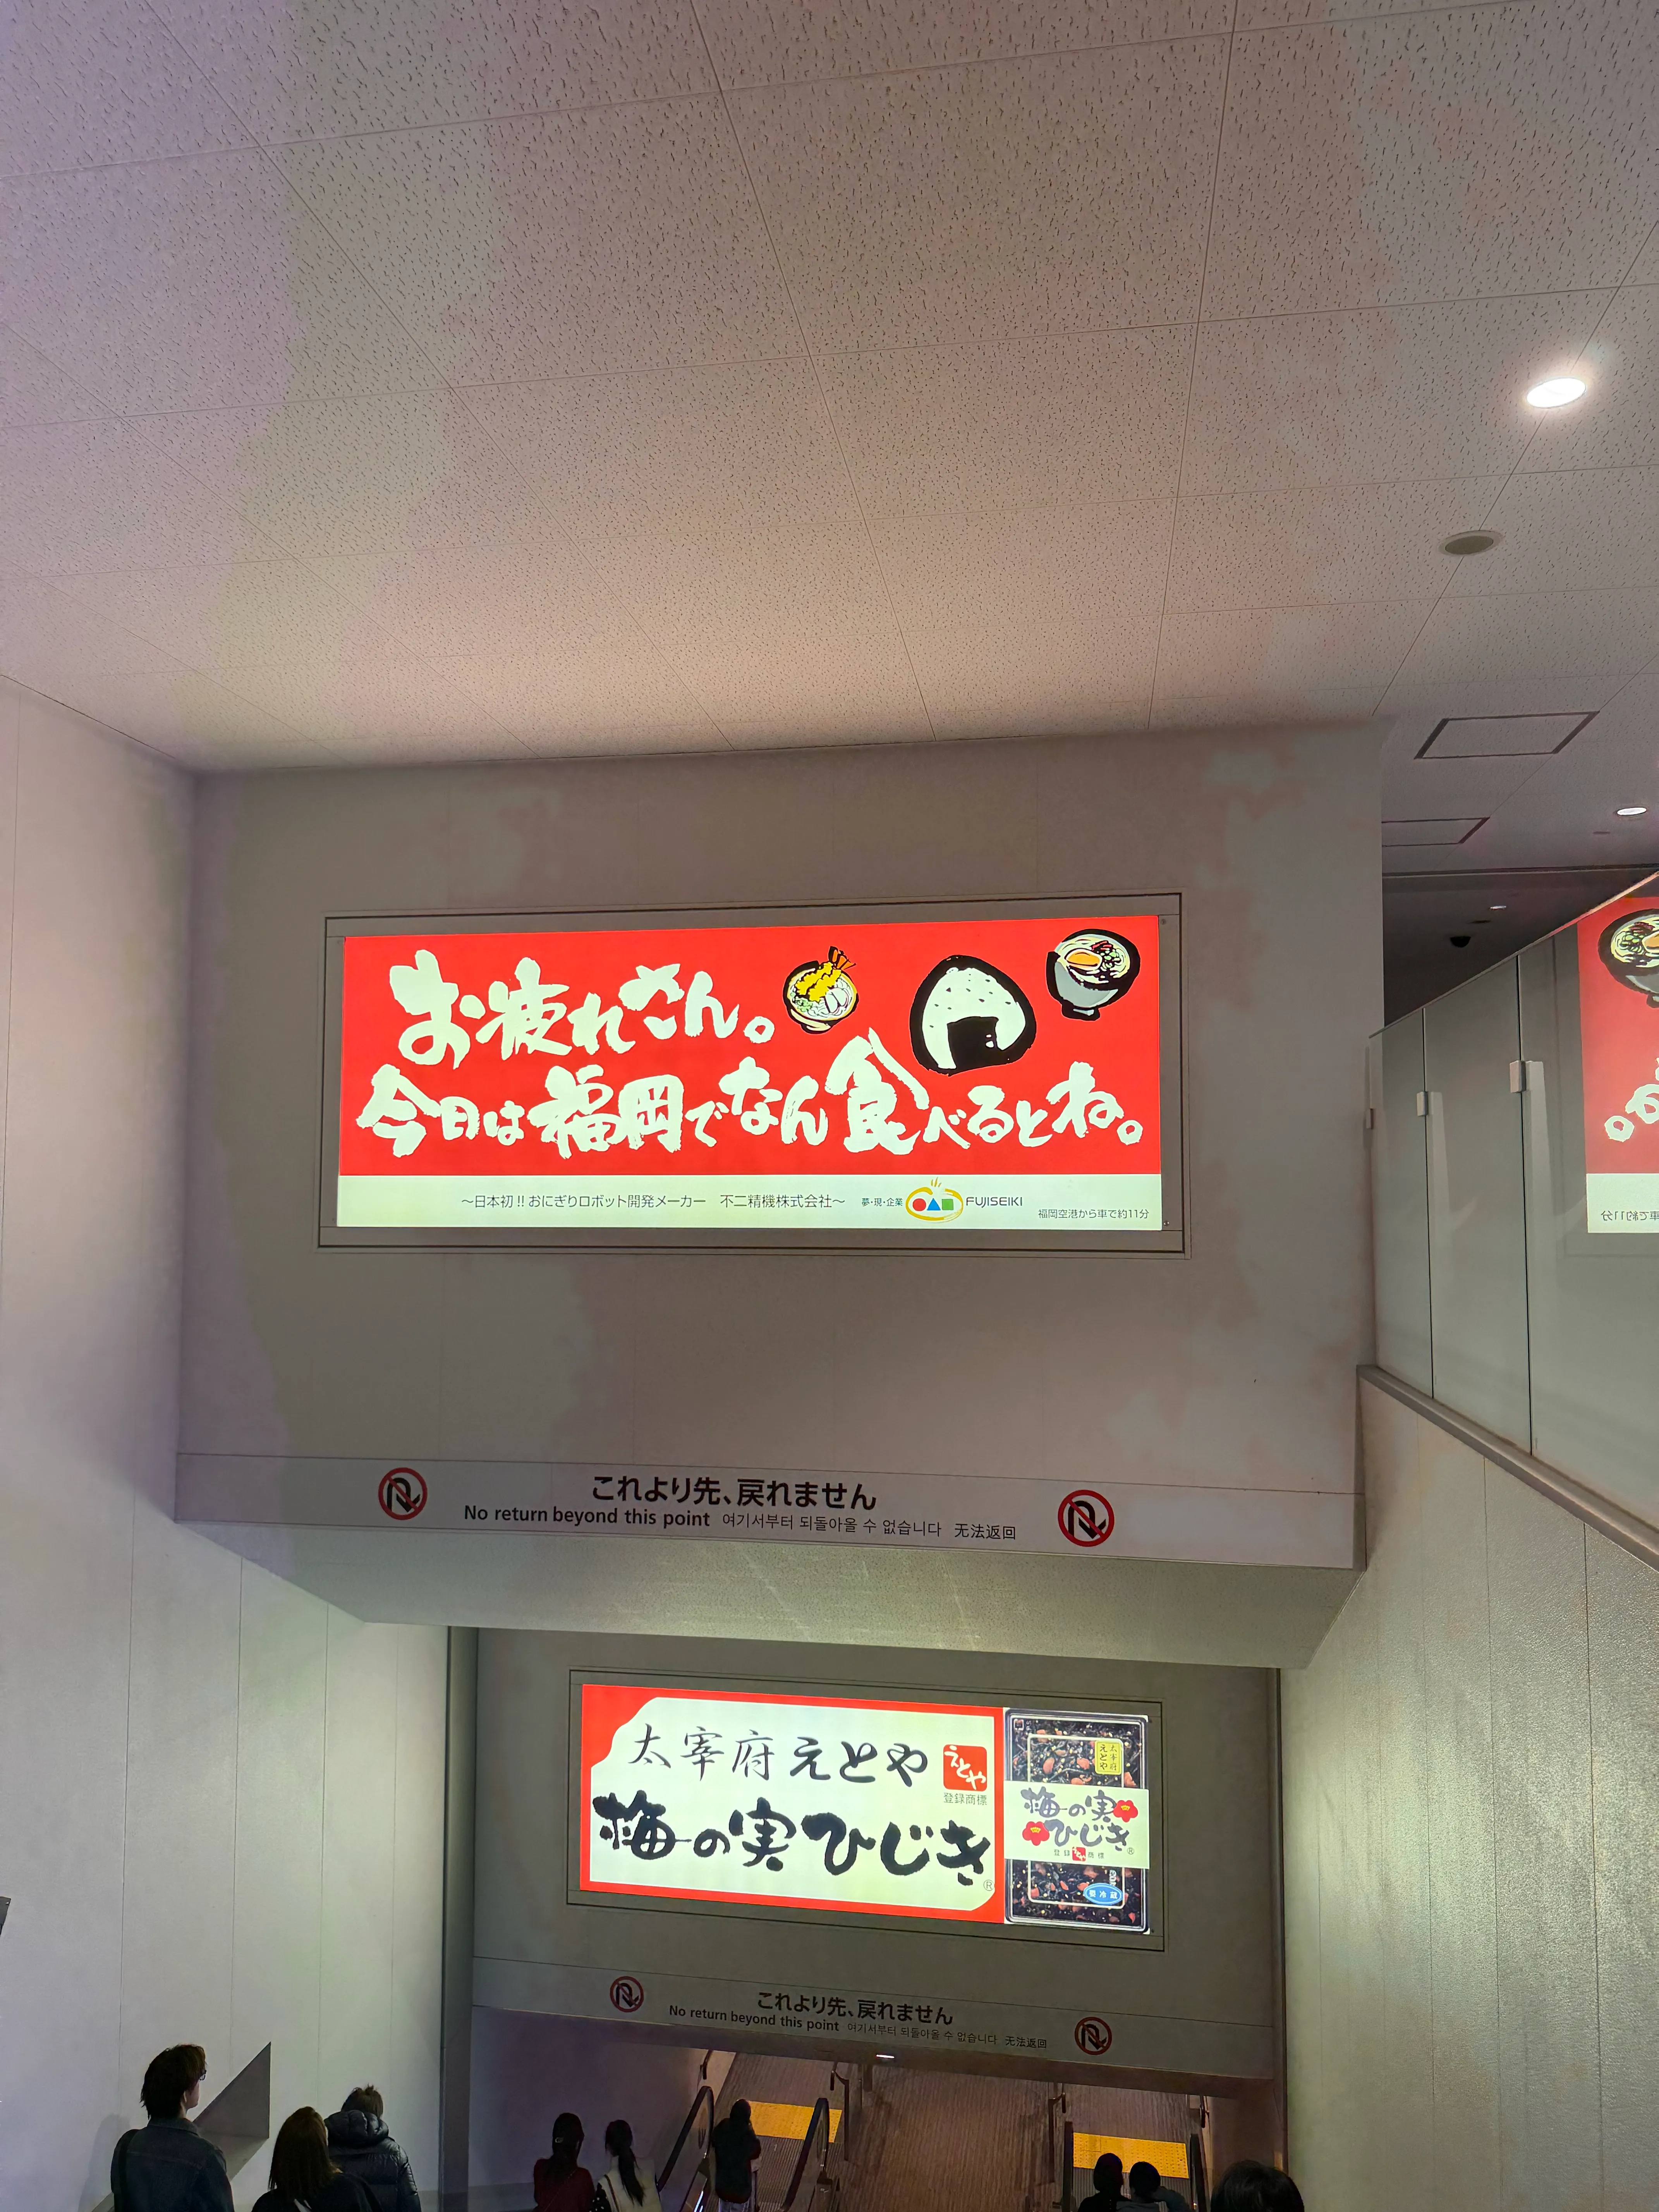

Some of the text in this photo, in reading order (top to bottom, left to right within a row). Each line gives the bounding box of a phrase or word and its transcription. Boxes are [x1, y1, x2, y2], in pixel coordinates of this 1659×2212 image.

[390, 950, 775, 1070] お疲れさん。
[356, 1027, 1143, 1159] 今日は福岡でなん食べるとね。
[720, 1194, 845, 1208] 不二精機株式会社〜
[966, 1197, 1023, 1208] FUJISEIKI
[1038, 1209, 1149, 1219] 福岡空港から車で約11分
[592, 1476, 877, 1510] これより先、戻れません
[465, 1505, 710, 1529] No return beyond this point
[723, 1513, 942, 1537] 여기서부터 되돌아올 수 없습니다
[954, 1523, 1015, 1540] 无法返回
[944, 1745, 987, 1786] えとや
[1099, 1744, 1108, 1771] えとや
[943, 1792, 987, 1806] 登録商標
[1020, 1786, 1117, 1823] 梅の実
[592, 1790, 991, 1886] 梅の実ひじき
[1044, 1819, 1130, 1851] ひじき
[670, 2005, 839, 2032] No return beyond this point
[758, 1992, 953, 2025] これより先、戻れません
[848, 2023, 998, 2045] 여기서부터 되돌아올 수 없습니다
[1005, 2036, 1047, 2049] 无法返回
